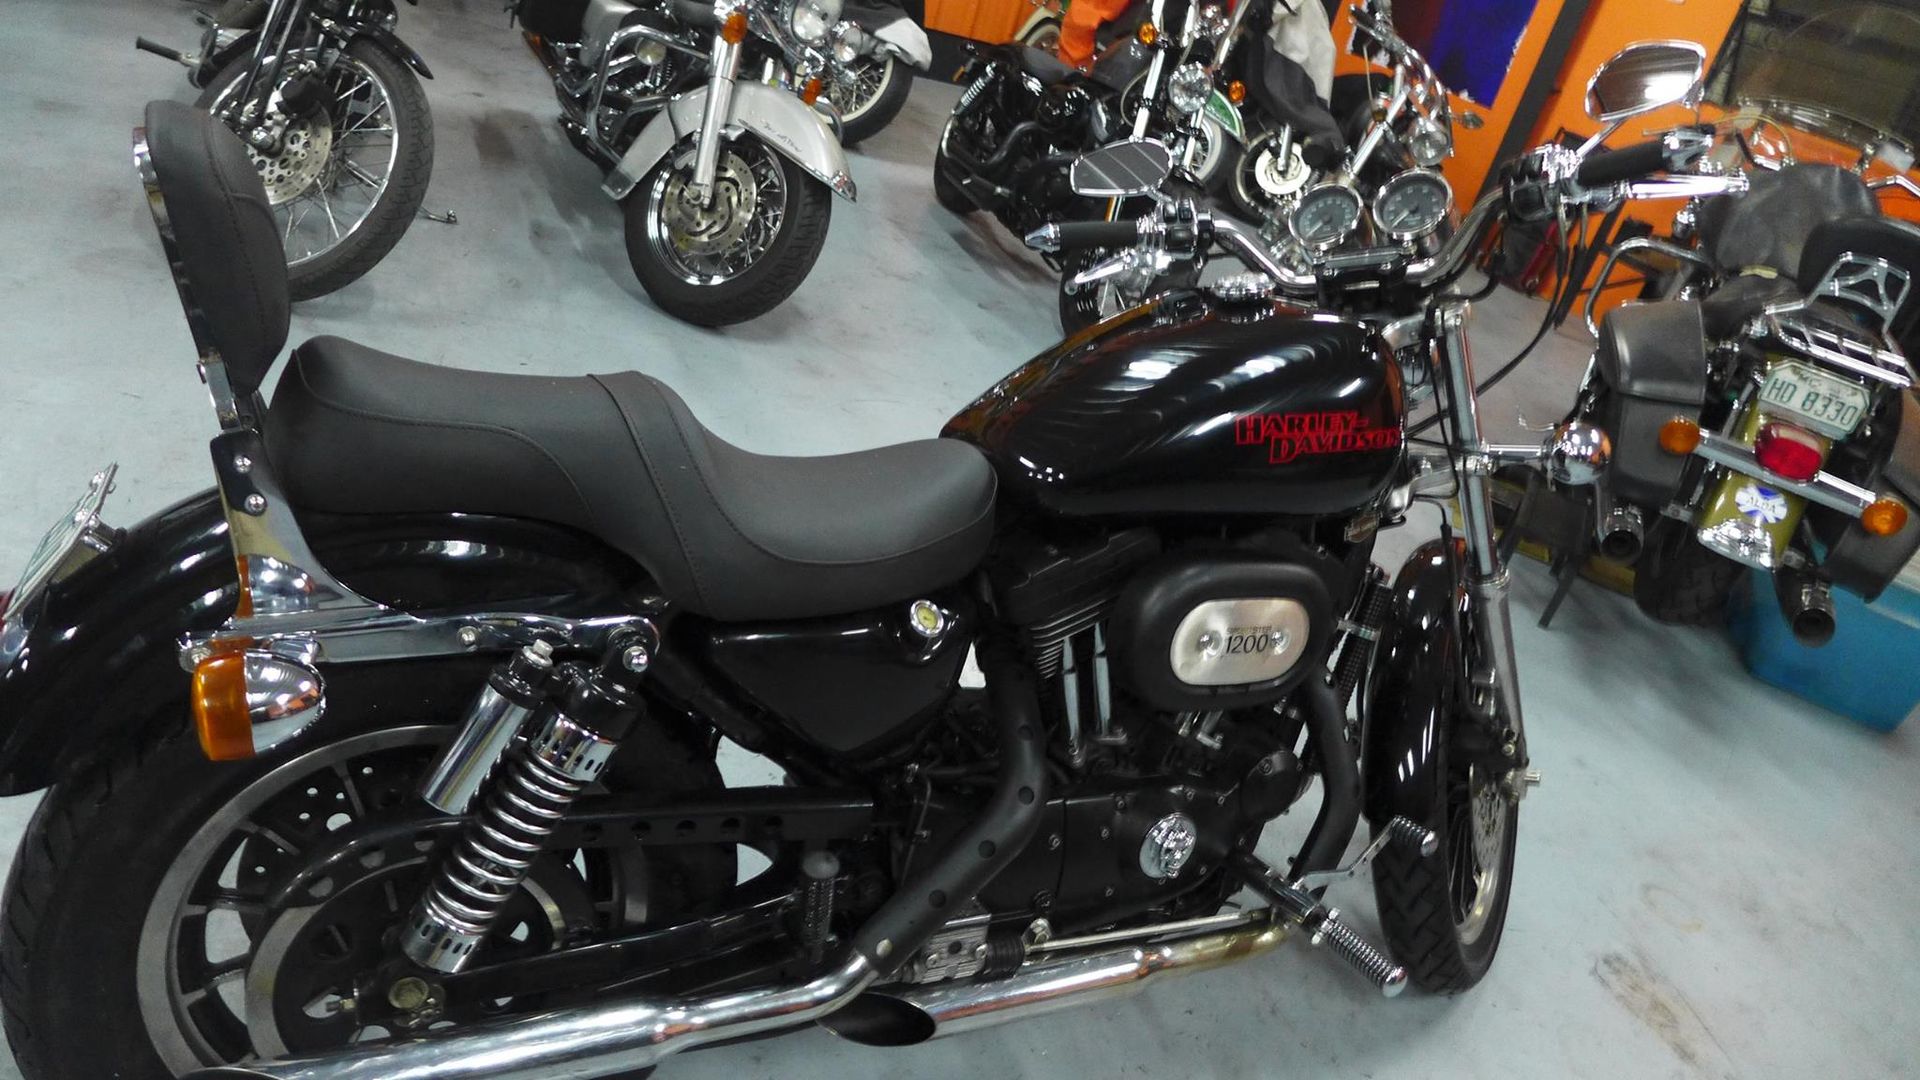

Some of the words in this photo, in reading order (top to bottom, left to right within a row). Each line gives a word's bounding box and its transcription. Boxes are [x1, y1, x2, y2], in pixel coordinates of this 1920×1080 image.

[1767, 378, 1798, 404] HD
[1801, 391, 1859, 426] 8330
[1226, 634, 1269, 654] 1200
